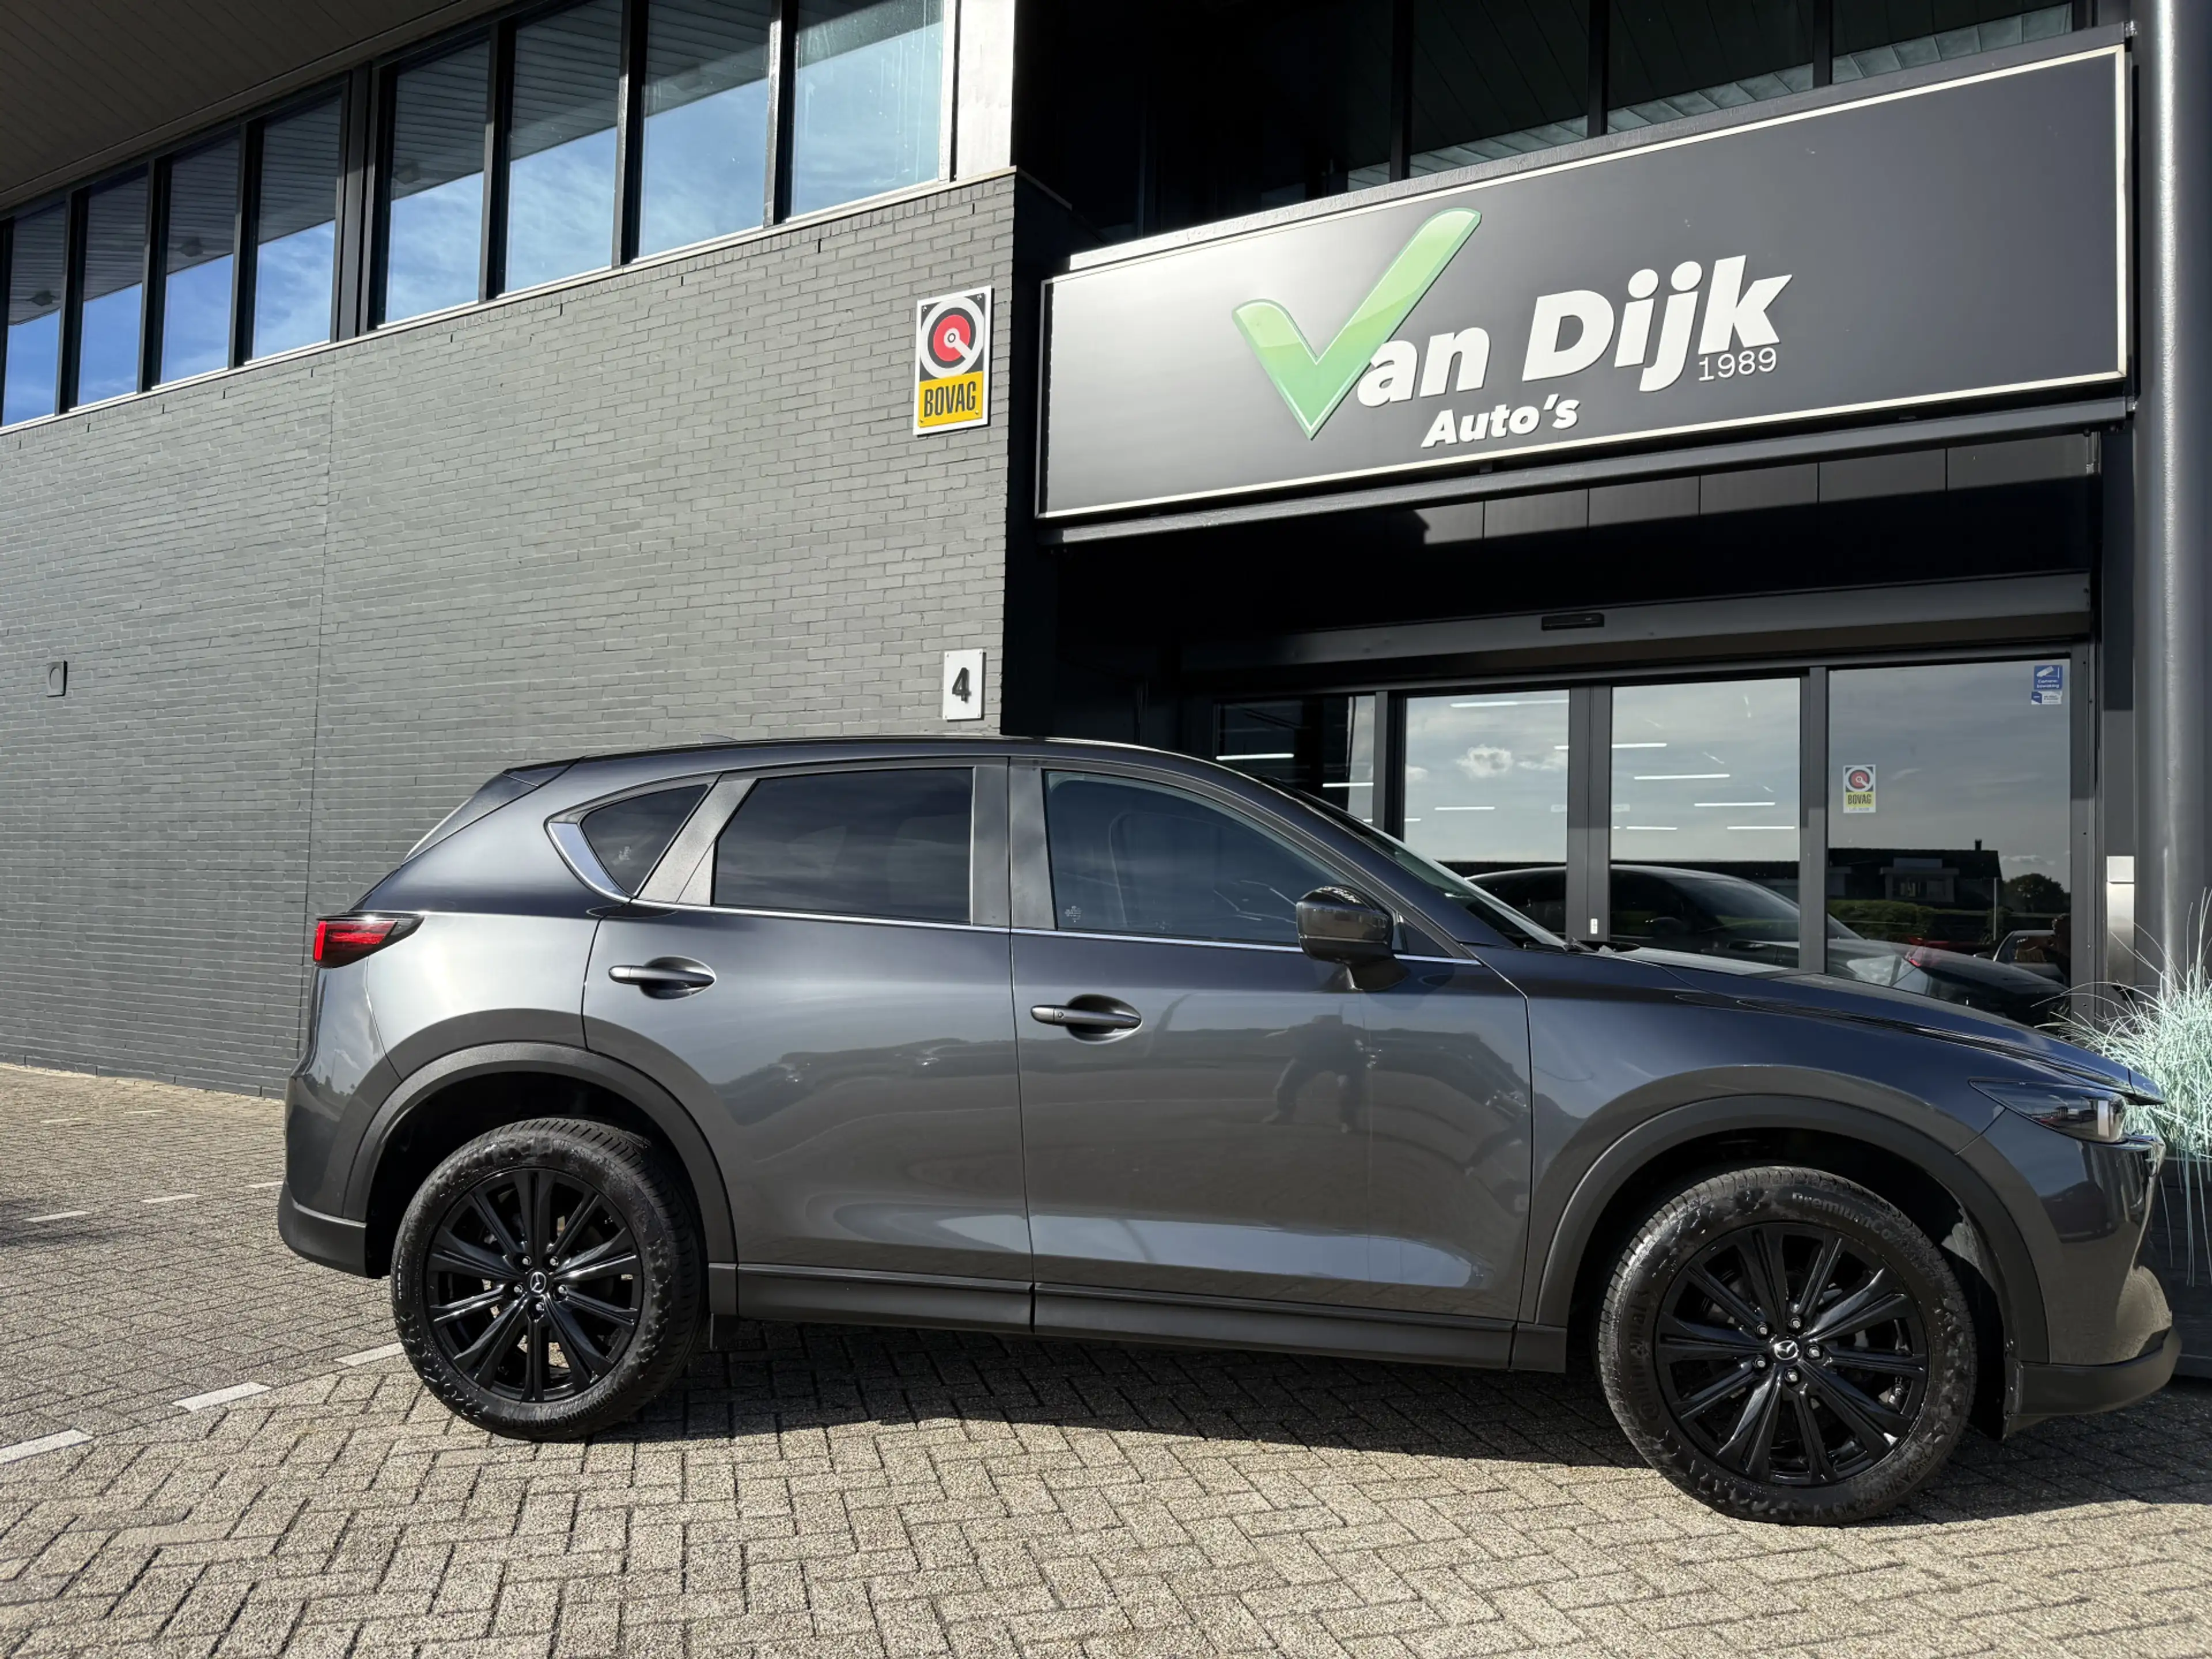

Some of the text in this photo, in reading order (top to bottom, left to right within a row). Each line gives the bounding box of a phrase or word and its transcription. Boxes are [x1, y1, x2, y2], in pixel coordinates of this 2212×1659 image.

[1522, 255, 1792, 392] Dijk
[1698, 347, 1777, 381] 1989
[923, 381, 976, 417] BOVAG
[1421, 394, 1580, 448] Auto's
[952, 667, 971, 703] 4
[1848, 794, 1872, 805] BOVAG
